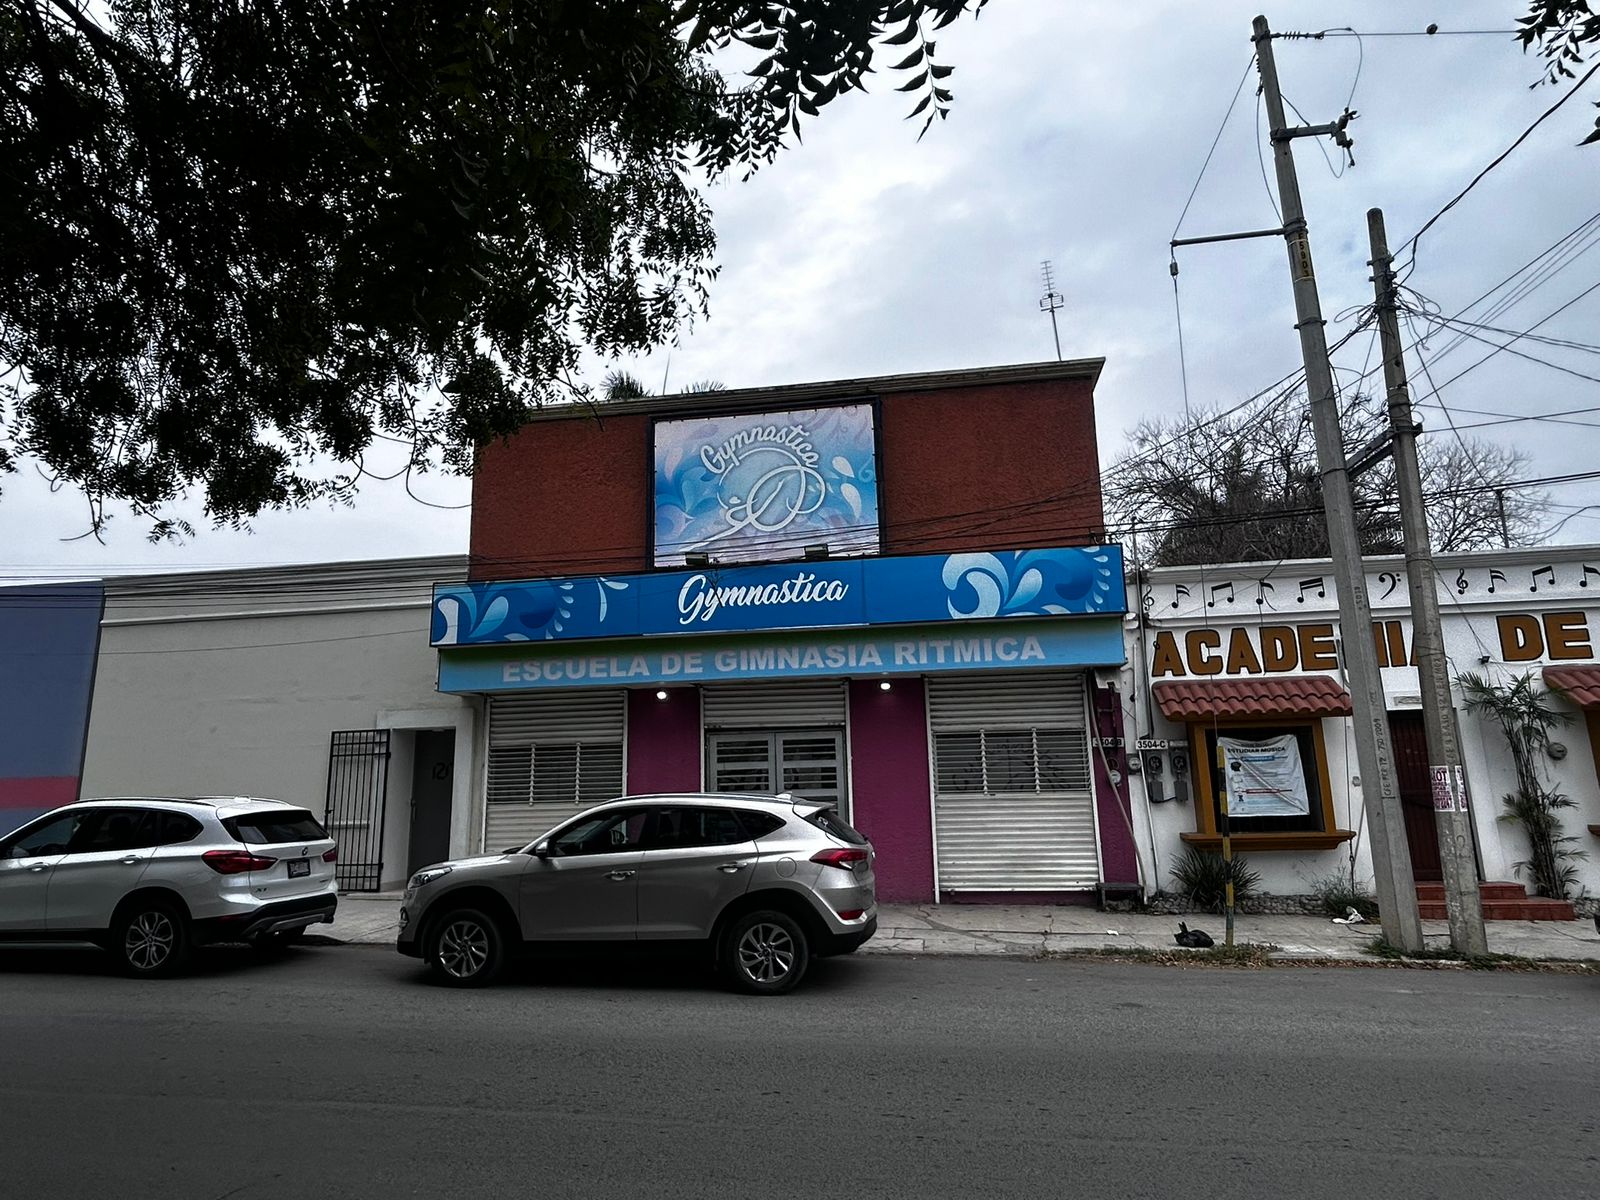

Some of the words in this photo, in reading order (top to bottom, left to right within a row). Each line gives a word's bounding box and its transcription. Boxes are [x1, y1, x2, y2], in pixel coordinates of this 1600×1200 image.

[700, 424, 819, 474] Gymnastica
[678, 572, 849, 625] Gymnastica
[502, 655, 650, 683] ESCUELA
[661, 653, 703, 675] DE
[714, 643, 884, 672] GIMNASIA
[1151, 620, 1418, 678] ACADEI
[1496, 611, 1593, 661] DE
[1137, 740, 1166, 749] 3504-C
